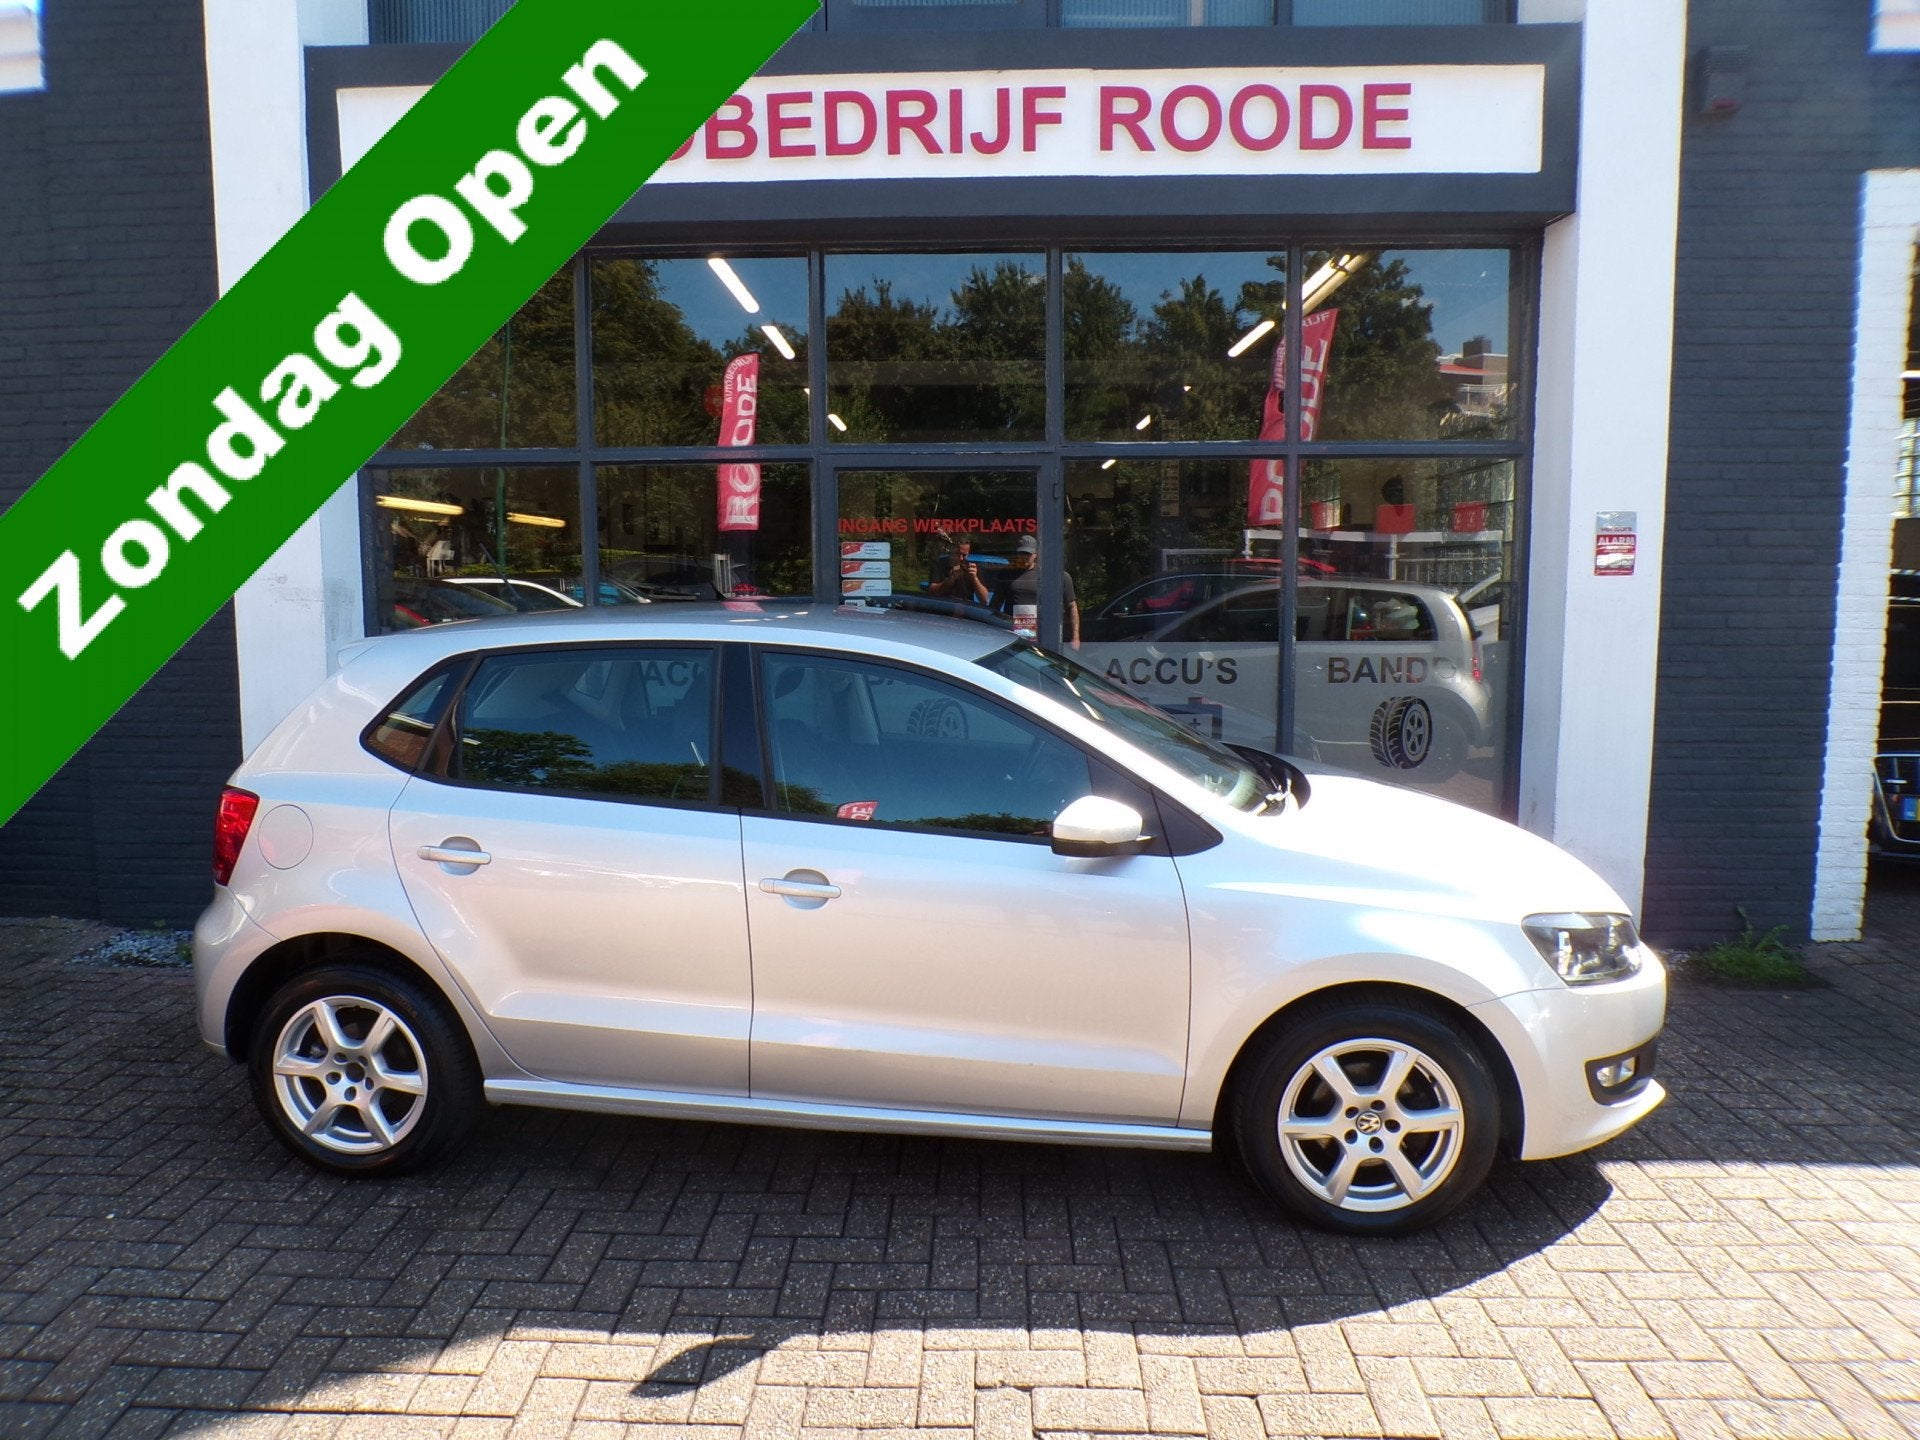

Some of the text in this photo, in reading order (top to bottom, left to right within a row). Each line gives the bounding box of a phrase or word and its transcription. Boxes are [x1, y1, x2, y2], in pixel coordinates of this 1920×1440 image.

[668, 83, 1412, 161] BEDRIJF ROODE
[838, 518, 1038, 533] INGANG WERKPLAATS
[1598, 536, 1635, 546] ALARM
[1328, 656, 1448, 684] BAND
